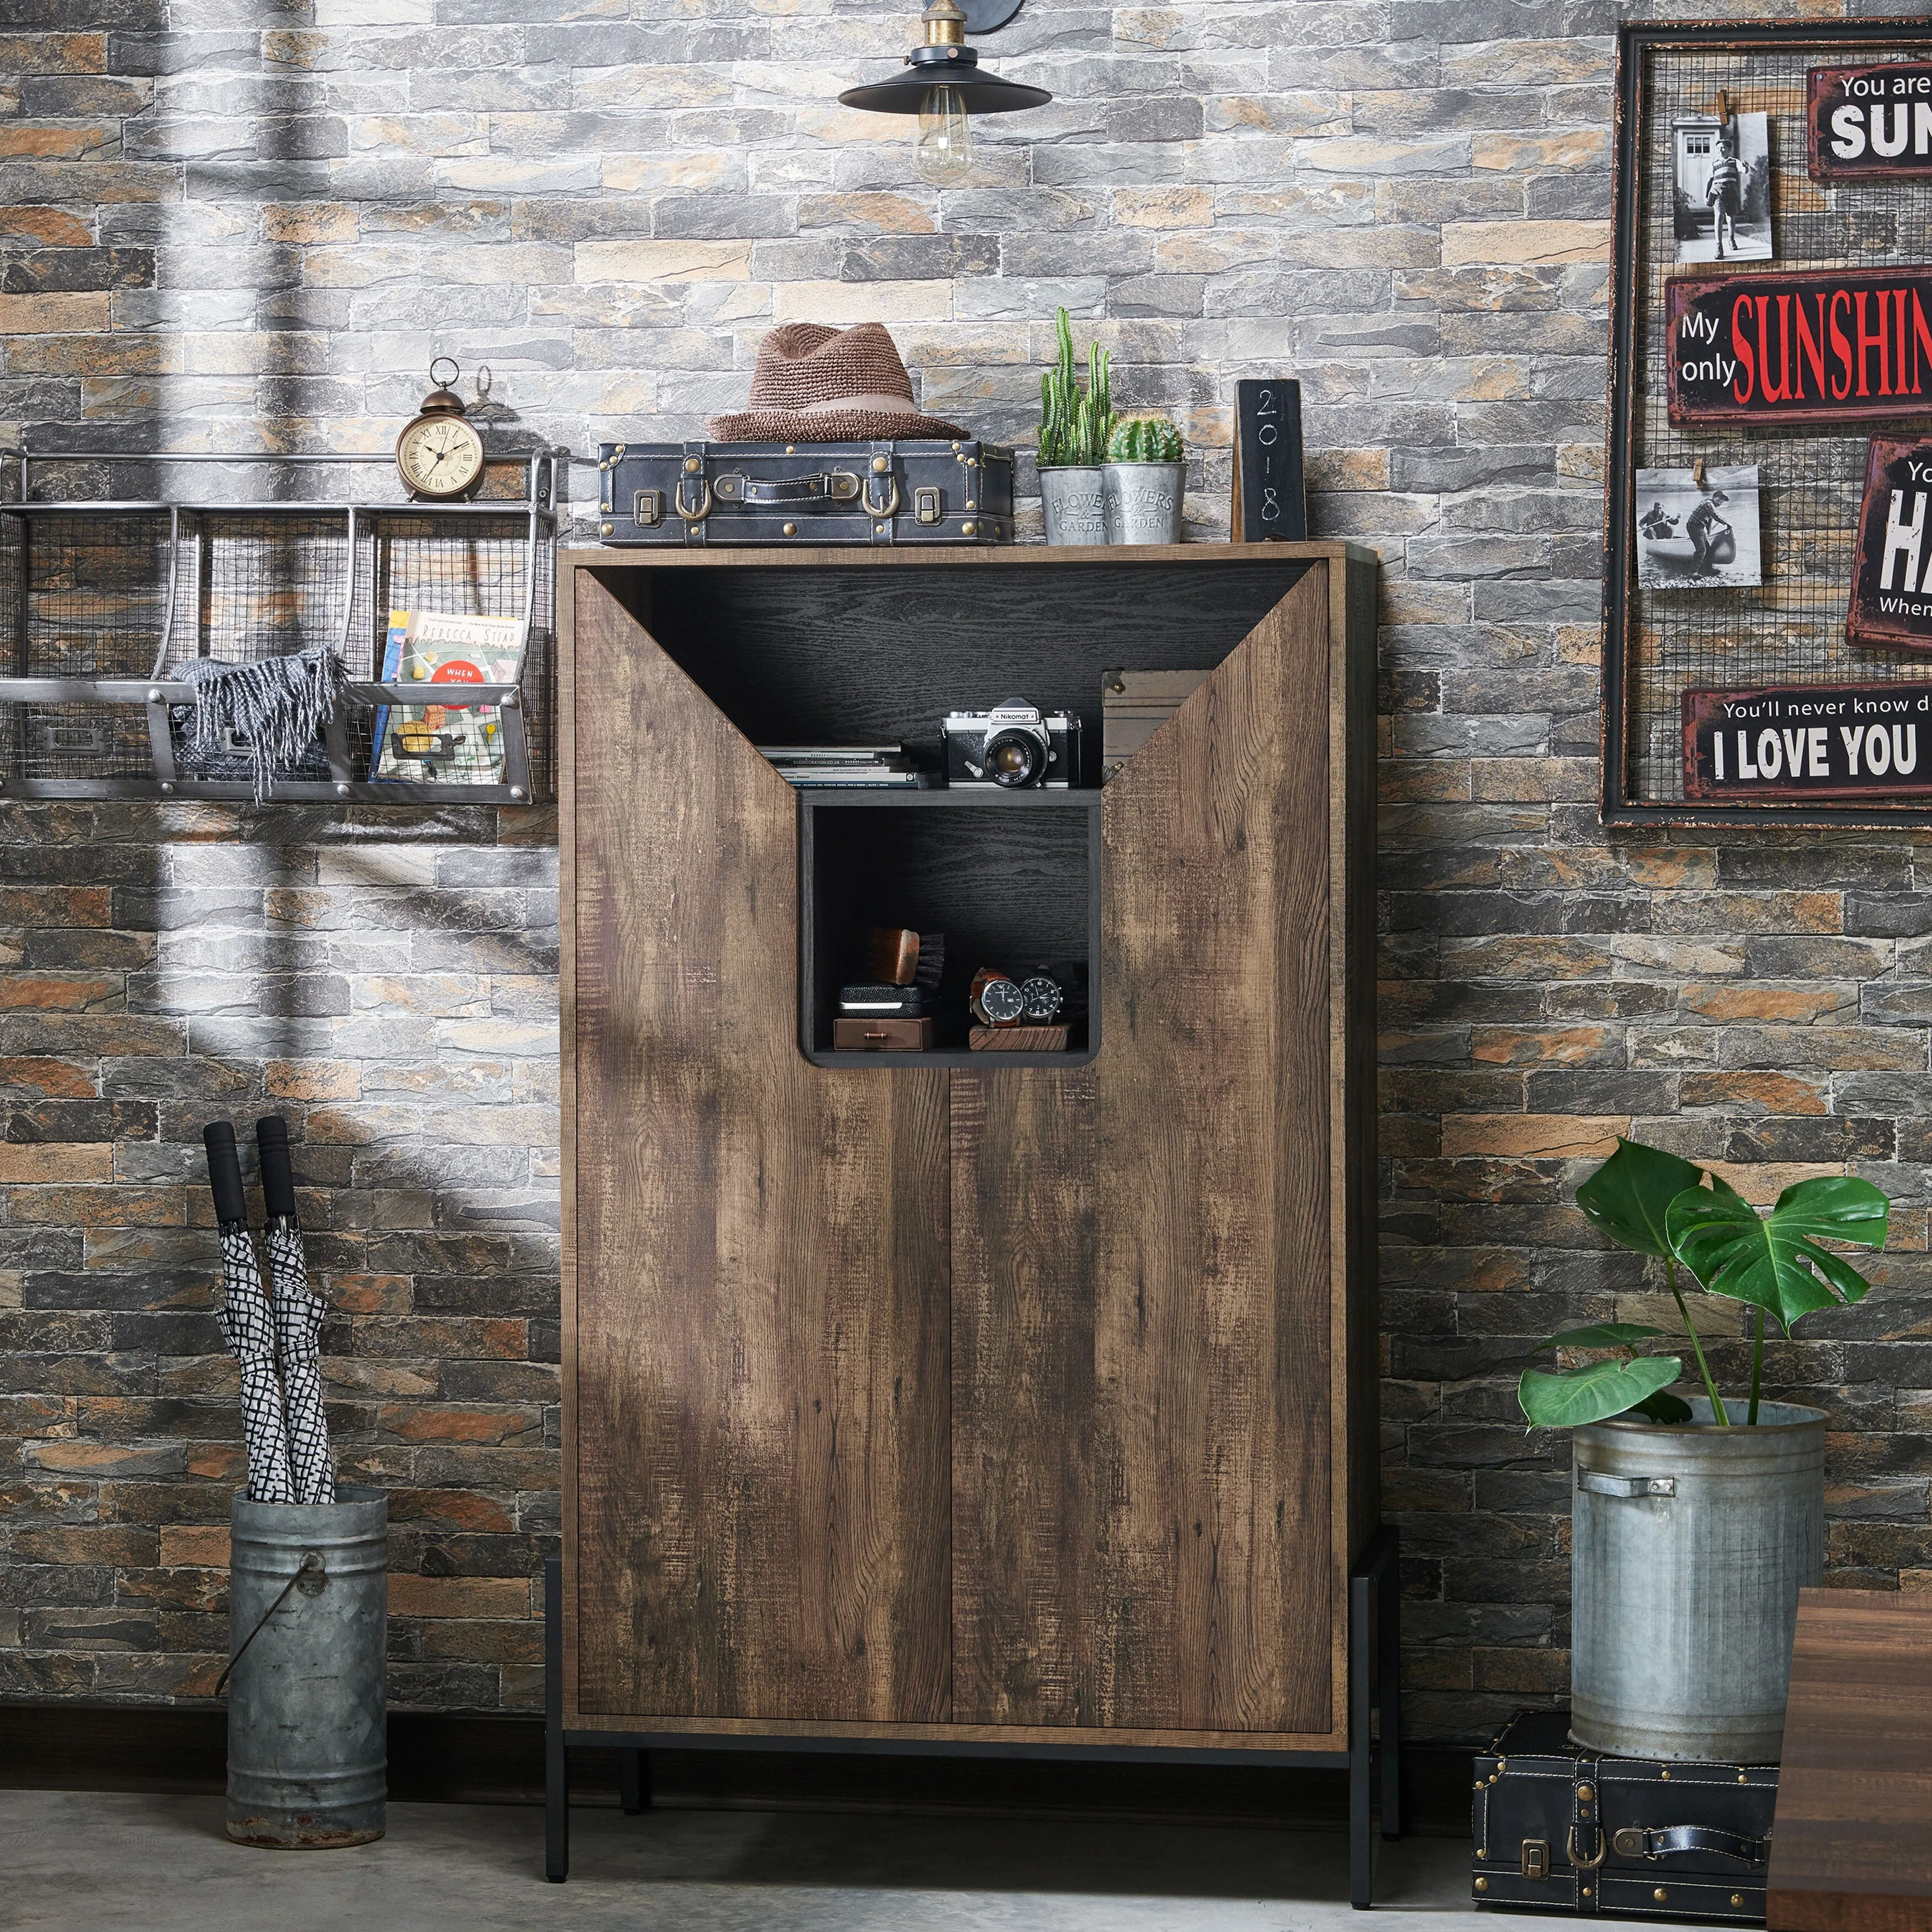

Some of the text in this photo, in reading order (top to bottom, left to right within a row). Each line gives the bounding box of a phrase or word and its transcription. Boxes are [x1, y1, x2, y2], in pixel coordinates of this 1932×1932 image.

[1839, 76, 1931, 97] You are
[1681, 312, 1719, 344] My
[1732, 287, 1932, 404] SUNSHIN
[1681, 353, 1736, 387] only
[421, 428, 431, 439] XI
[436, 426, 446, 434] XII
[413, 439, 422, 447] X
[411, 463, 423, 477] VIII
[459, 466, 469, 477] IV
[1908, 461, 1932, 482] Yo
[436, 479, 443, 487] VI
[451, 476, 457, 485] V
[1107, 489, 1174, 512] FLOWERS
[1081, 509, 1090, 519] &
[1114, 516, 1164, 528] GARDEN
[1059, 520, 1107, 532] GARDEN
[1880, 489, 1932, 593] H
[1880, 597, 1932, 617] When
[423, 624, 514, 643] REBECCA STEAD
[447, 668, 473, 677] WHEN
[1788, 702, 1845, 716] never
[1854, 698, 1909, 714] know
[1917, 695, 1932, 712] d
[1713, 724, 1917, 780] I LOVE YOU
